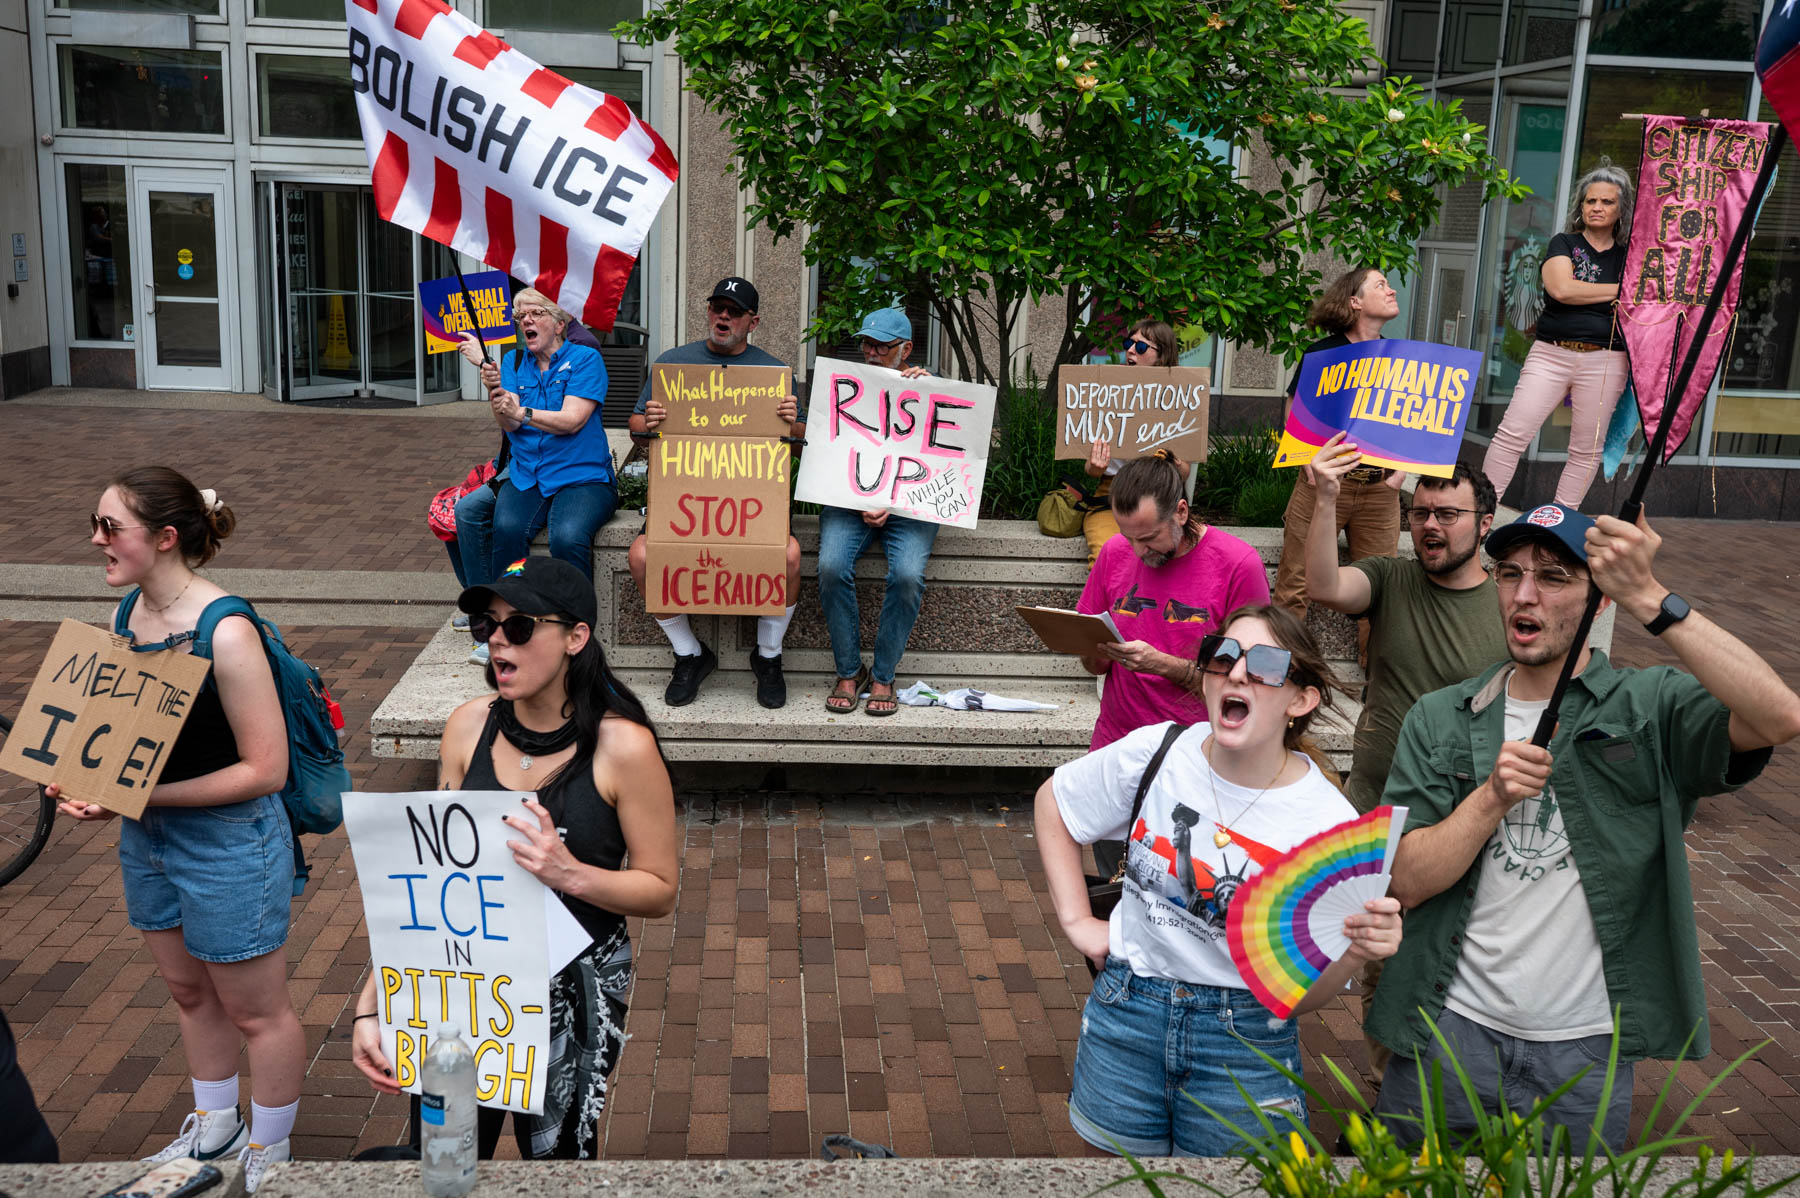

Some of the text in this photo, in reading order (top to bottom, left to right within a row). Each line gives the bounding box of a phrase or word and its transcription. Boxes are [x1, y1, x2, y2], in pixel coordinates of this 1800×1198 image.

[350, 27, 648, 226] BOLISH ICE
[1647, 126, 1766, 172] CITIZEN
[1656, 162, 1727, 201] SHIP
[1659, 205, 1719, 242] FOR
[1634, 244, 1716, 306] ALL
[443, 306, 511, 334] OVEROME.
[447, 292, 467, 313] WE
[660, 369, 786, 407] What Happened
[1065, 383, 1205, 411] DEPORTATIONS
[1316, 357, 1469, 402] NO HUMAN IS
[688, 407, 748, 427] to our
[829, 373, 976, 459] RISE
[1065, 409, 1197, 447] MUST end
[1349, 388, 1462, 436] ILLEGAL!
[661, 439, 790, 482] HUMANITY?
[848, 447, 931, 506] UP
[429, 504, 455, 517] TRAD
[670, 493, 763, 537] STOP
[927, 487, 953, 516] YOU
[940, 493, 967, 519] CAN
[696, 547, 728, 568] the
[662, 565, 786, 607] ICE RAIDS
[52, 652, 190, 718] MELT THE
[22, 704, 165, 788] ICE!
[406, 803, 480, 869] NO
[1489, 841, 1545, 881] CHAN
[388, 872, 509, 941] ICE
[445, 939, 472, 966] IN
[381, 967, 543, 1037] PITTS-
[396, 1030, 536, 1110] BGH
